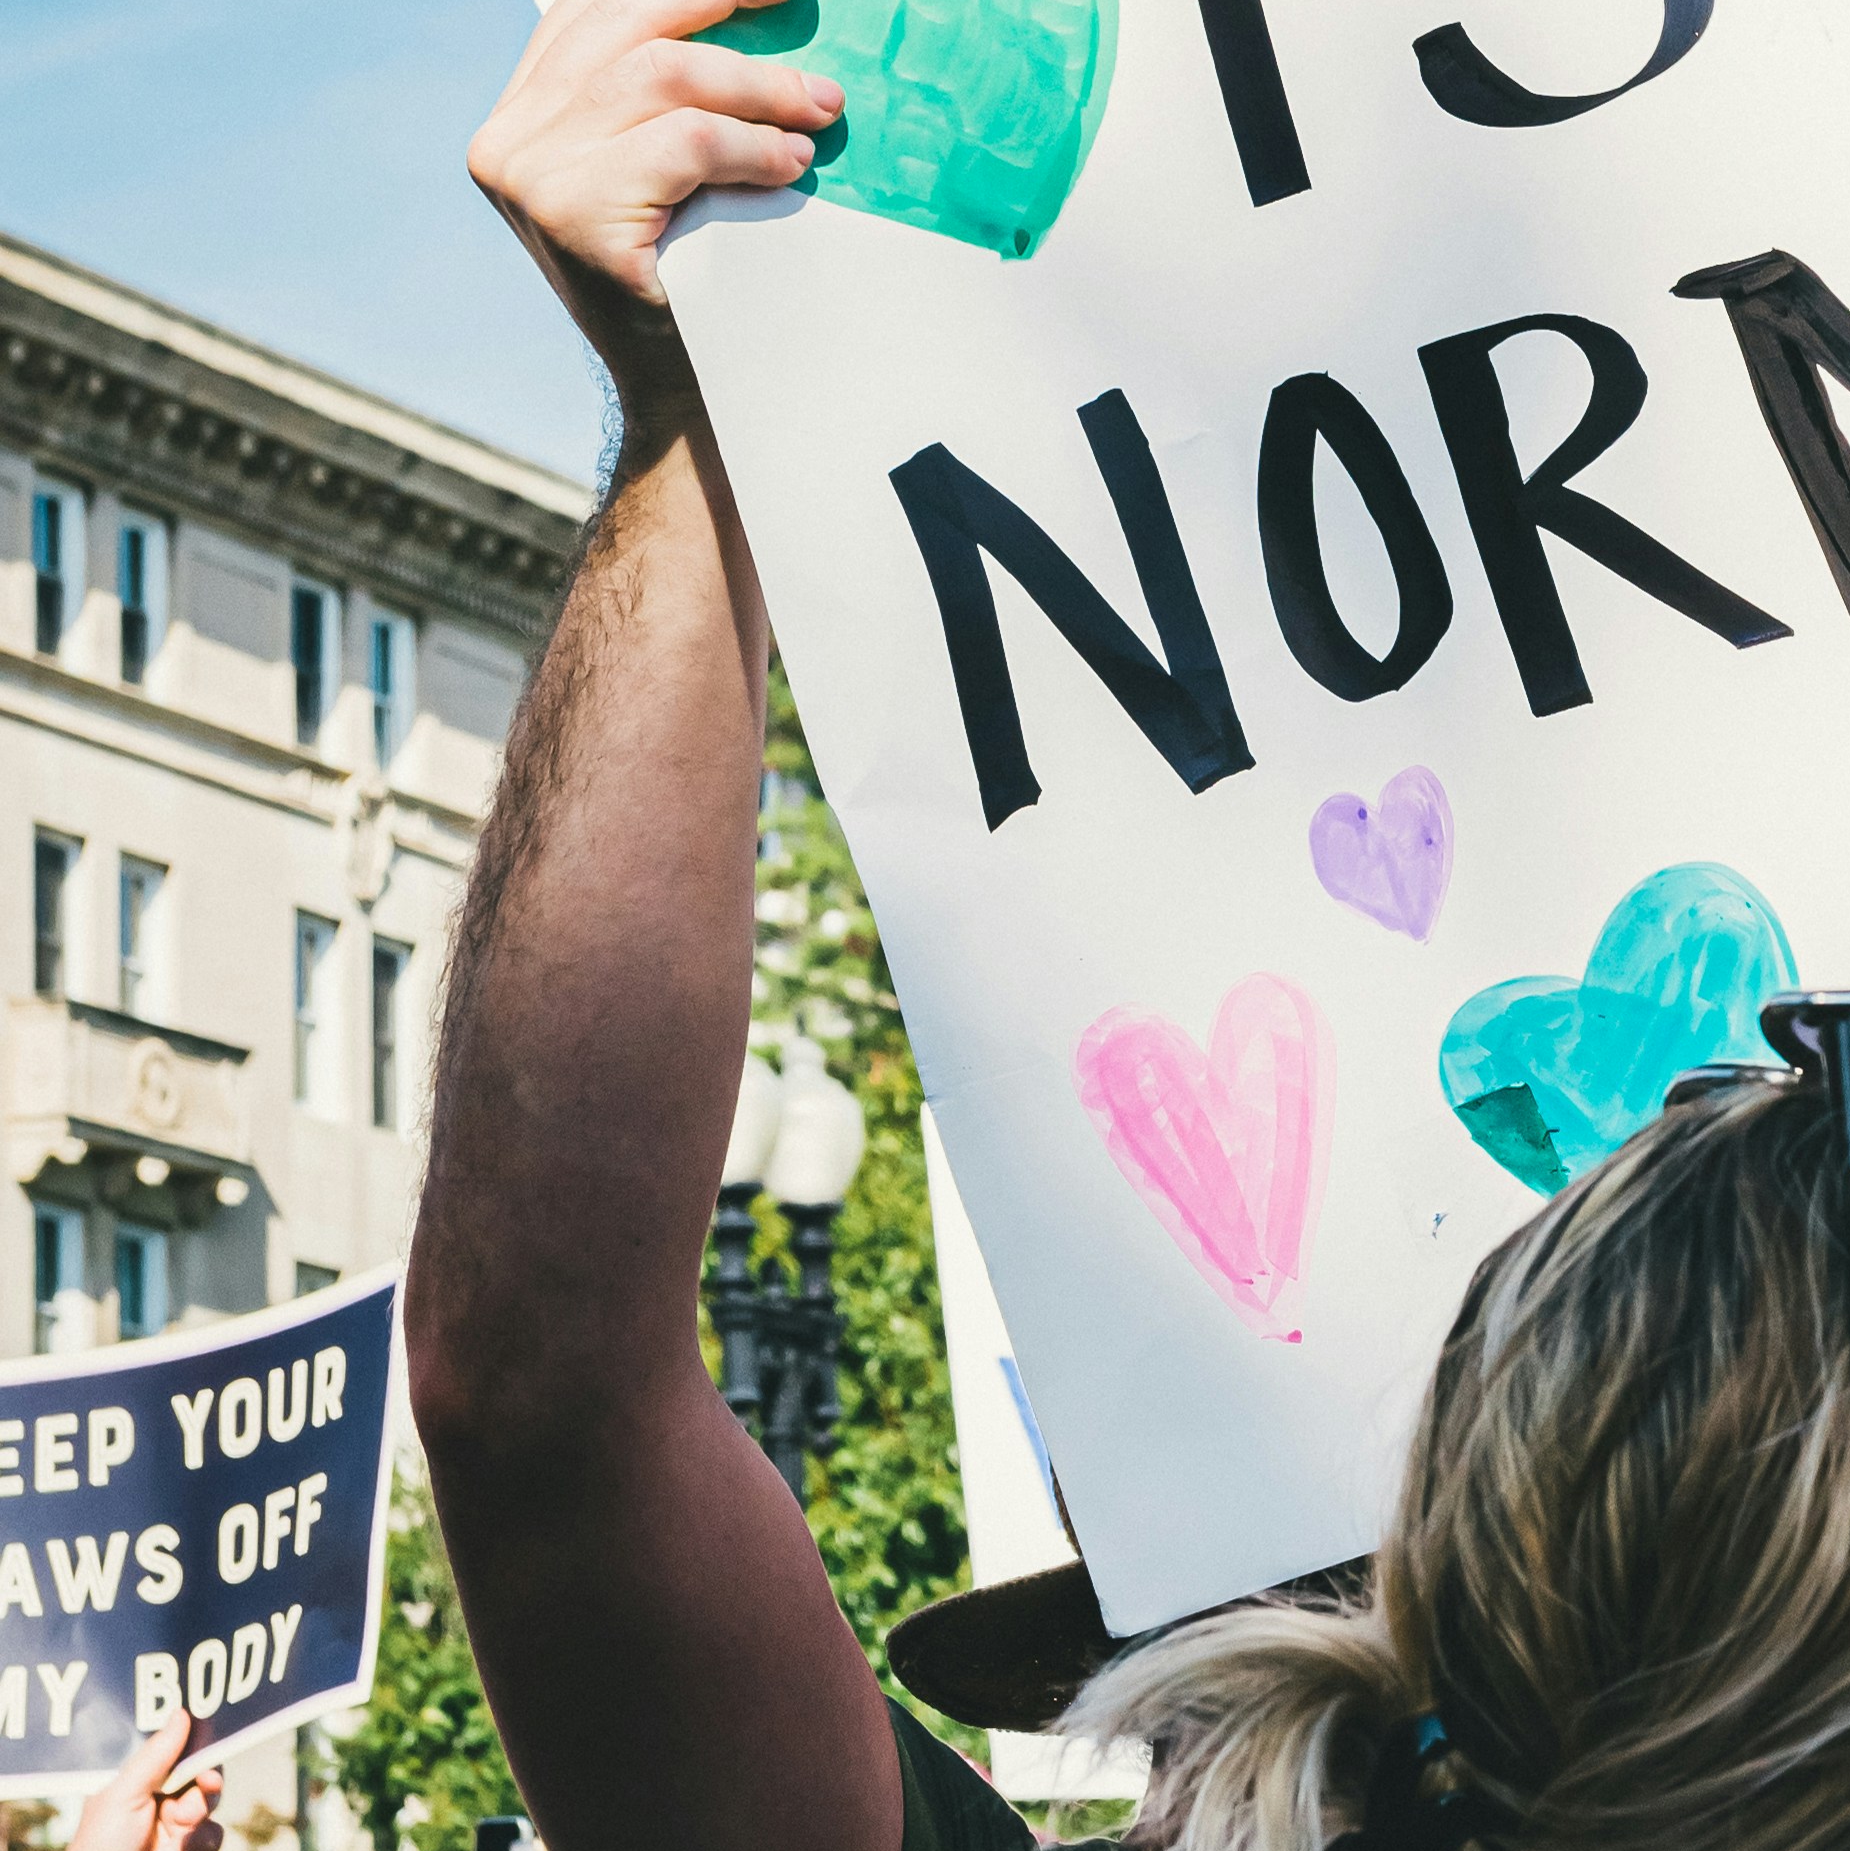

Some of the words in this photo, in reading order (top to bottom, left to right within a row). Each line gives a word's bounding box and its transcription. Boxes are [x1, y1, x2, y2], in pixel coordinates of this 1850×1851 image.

[170, 1345, 347, 1470] YOUR
[217, 1471, 328, 1585] OFF
[134, 1603, 303, 1734] BODY
